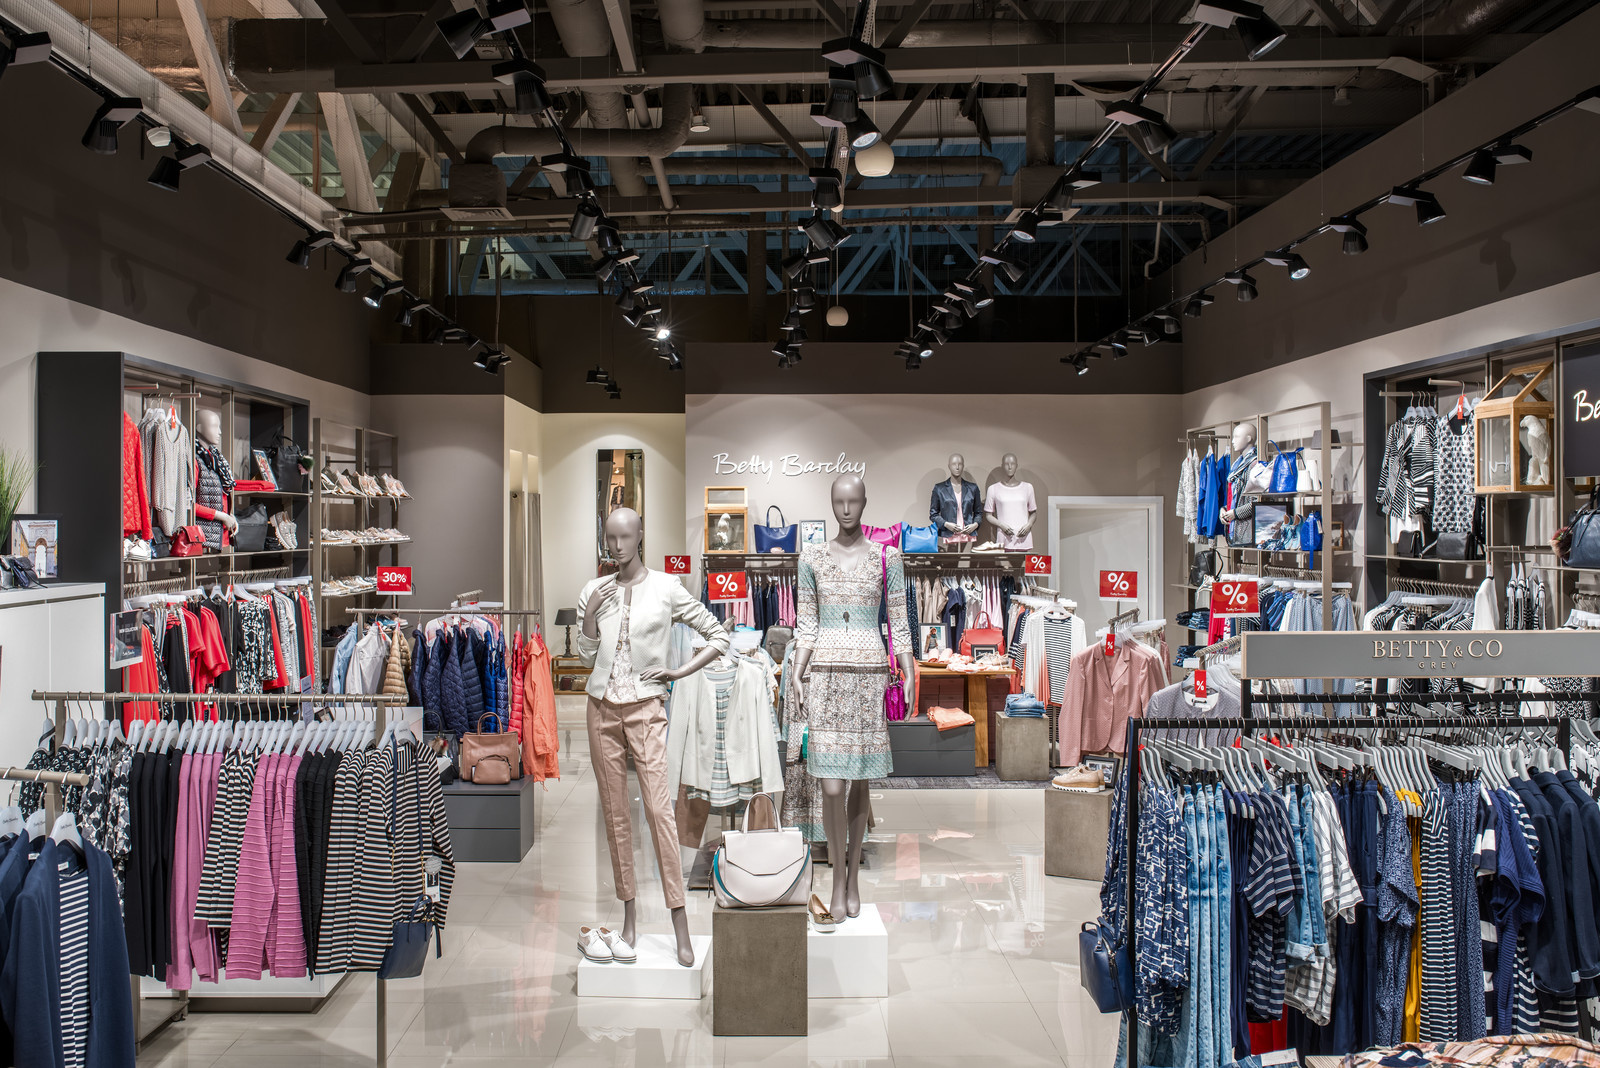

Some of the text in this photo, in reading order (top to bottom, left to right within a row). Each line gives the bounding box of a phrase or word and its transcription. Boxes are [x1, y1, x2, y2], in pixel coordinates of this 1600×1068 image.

[713, 452, 866, 484] Betty Barclay
[382, 572, 407, 583] 30%
[716, 573, 738, 593] %
[1107, 572, 1130, 591] %
[1221, 583, 1249, 605] %
[1418, 661, 1457, 669] GREY
